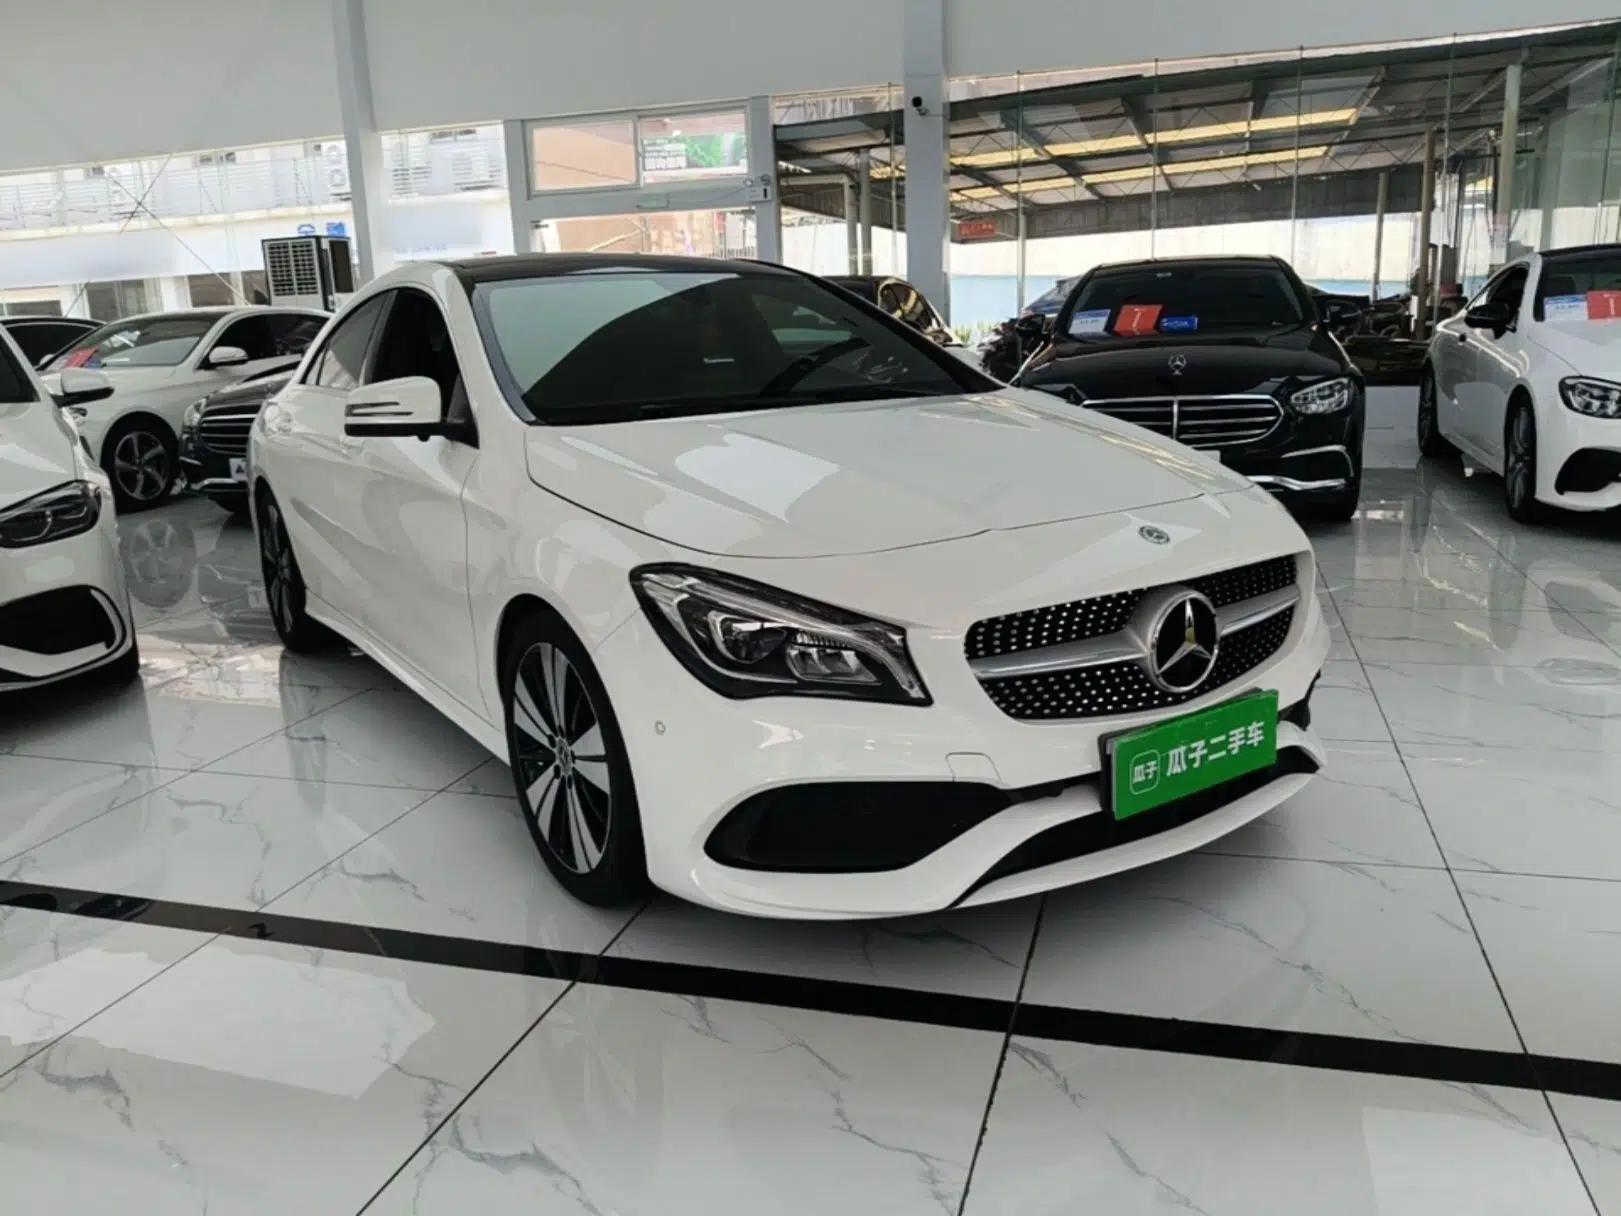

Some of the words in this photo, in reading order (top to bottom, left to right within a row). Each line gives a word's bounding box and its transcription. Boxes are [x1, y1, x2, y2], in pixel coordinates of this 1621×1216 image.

[1166, 720, 1265, 777] 瓜子二手车
[1132, 760, 1158, 784] 瓜子
